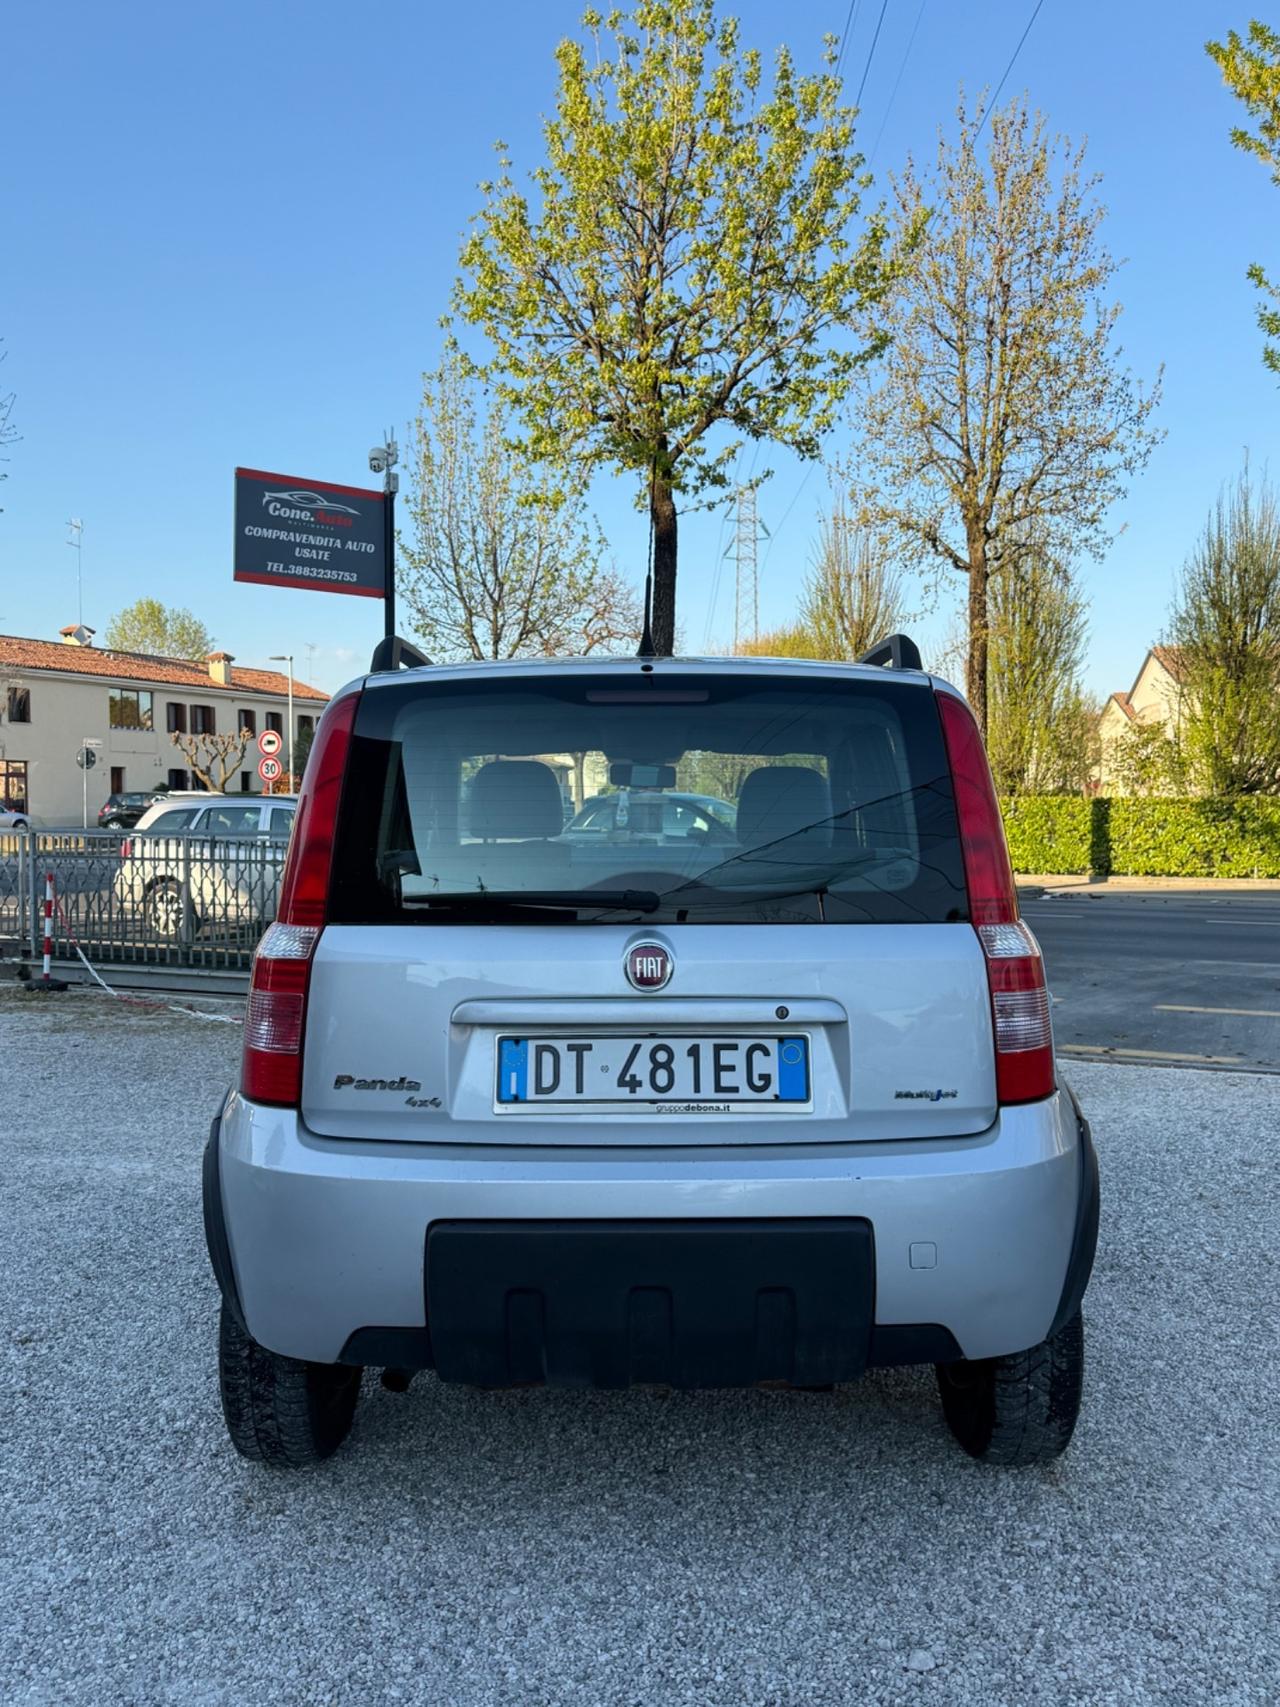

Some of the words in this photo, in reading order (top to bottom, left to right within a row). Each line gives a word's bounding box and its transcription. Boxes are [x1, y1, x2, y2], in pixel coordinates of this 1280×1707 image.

[244, 525, 342, 549] COMPRAVENDITA
[345, 540, 376, 554] AUTO
[294, 547, 331, 561] USATE
[266, 562, 358, 583] TEL.3883235753
[264, 763, 276, 775] 30
[636, 957, 663, 977] FIAT
[534, 1043, 593, 1095] DT
[616, 1043, 772, 1095] 481EG
[333, 1074, 421, 1091] Panda
[404, 1096, 442, 1108] 4x4
[656, 1103, 731, 1114] gruppodebona.it
